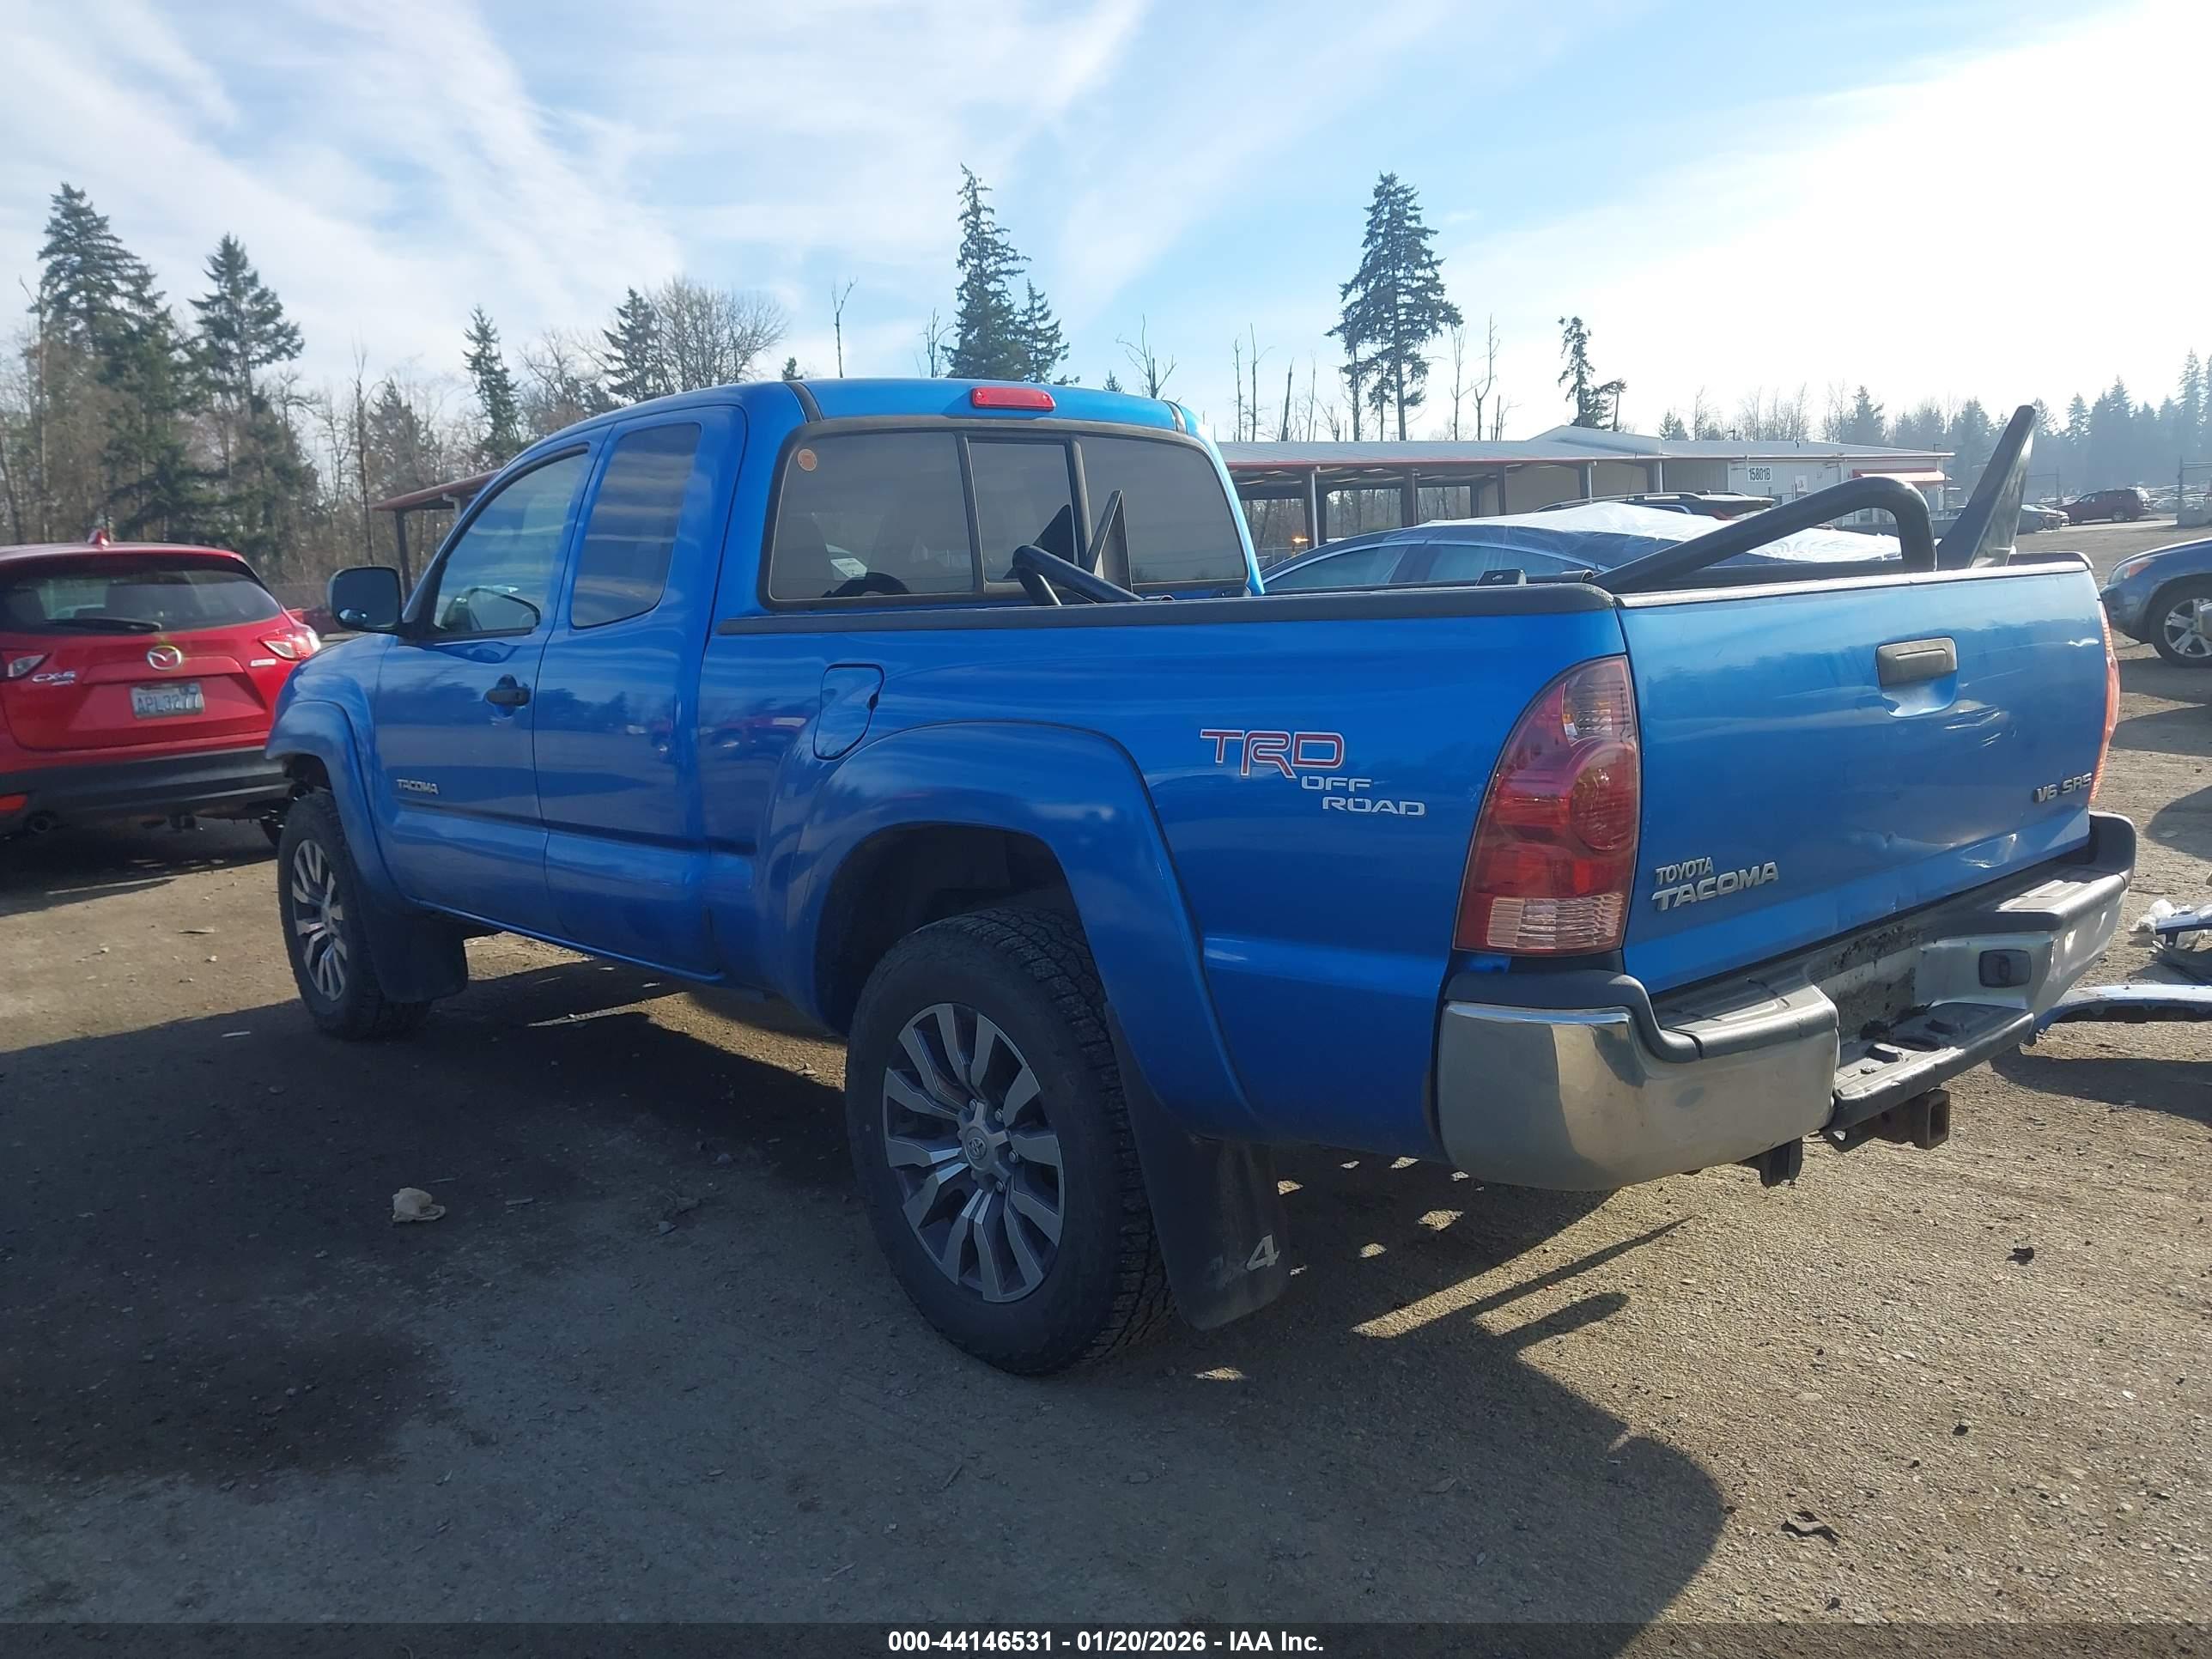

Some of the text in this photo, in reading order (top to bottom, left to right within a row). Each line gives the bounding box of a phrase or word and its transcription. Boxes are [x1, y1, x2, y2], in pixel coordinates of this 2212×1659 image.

[1200, 729, 1345, 779] TRD
[1301, 775, 1371, 791] OFF
[2036, 773, 2093, 803] V6 SR5
[1322, 796, 1425, 816] ROAD
[1656, 857, 1714, 885] TOYOTA
[1651, 861, 1779, 911] TACOMA
